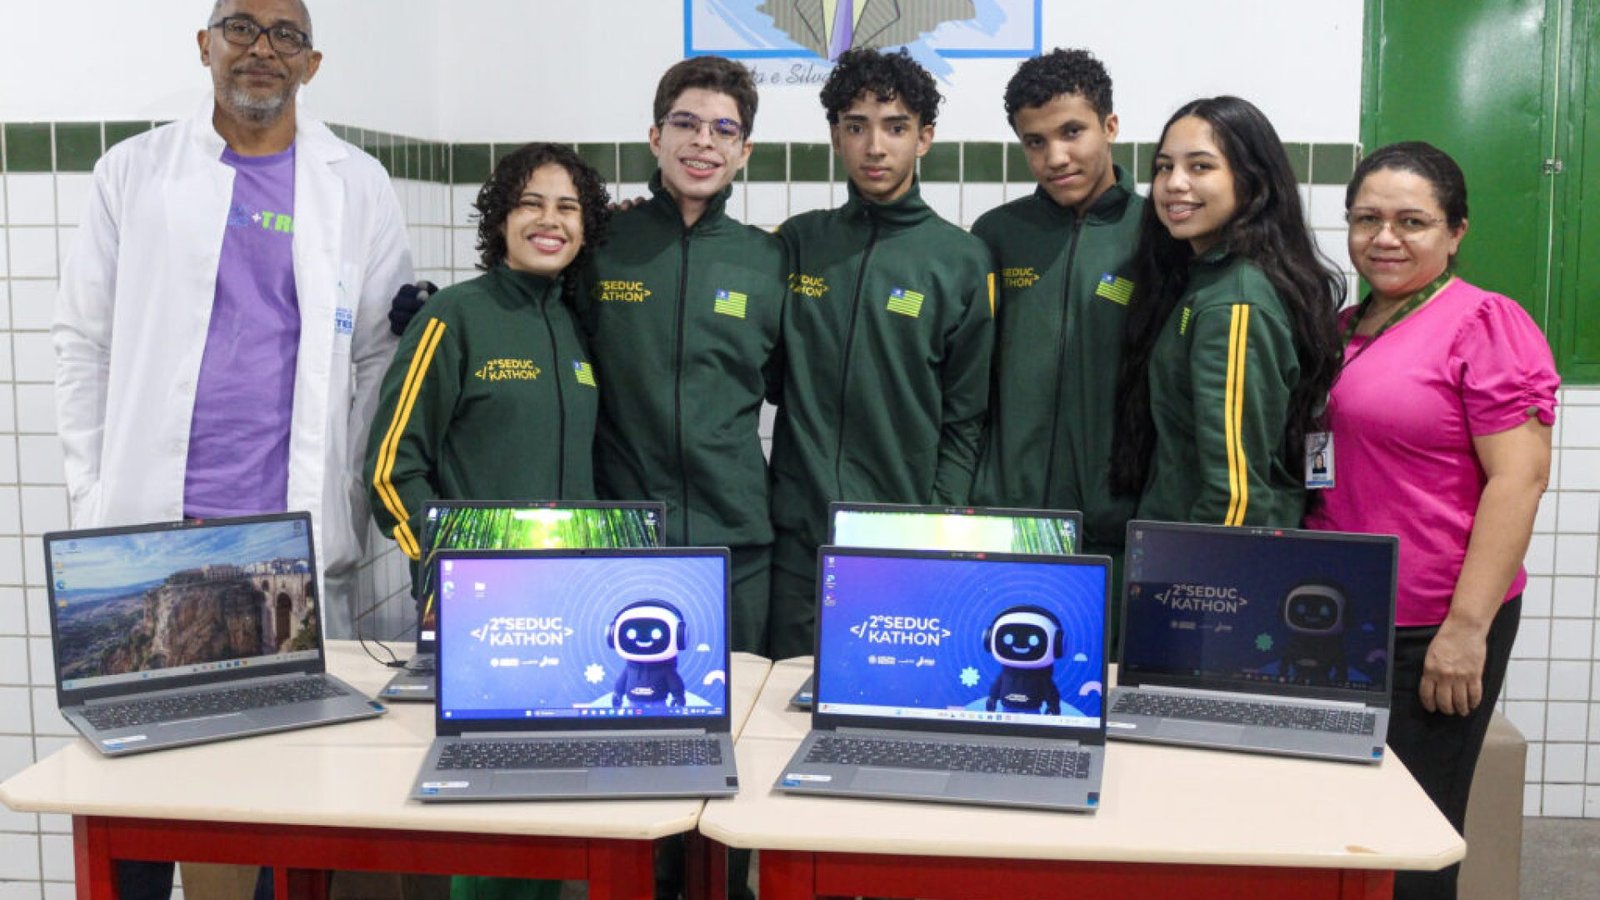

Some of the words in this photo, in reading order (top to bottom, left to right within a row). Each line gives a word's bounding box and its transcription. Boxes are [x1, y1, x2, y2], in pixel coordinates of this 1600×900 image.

[770, 72, 780, 84] e
[600, 280, 644, 291] SEDUC
[600, 291, 643, 302] ATHON
[488, 369, 537, 381] KATHON
[1171, 597, 1238, 613] KATHON
[489, 632, 564, 647] KATHON
[868, 630, 941, 647] KATHON
